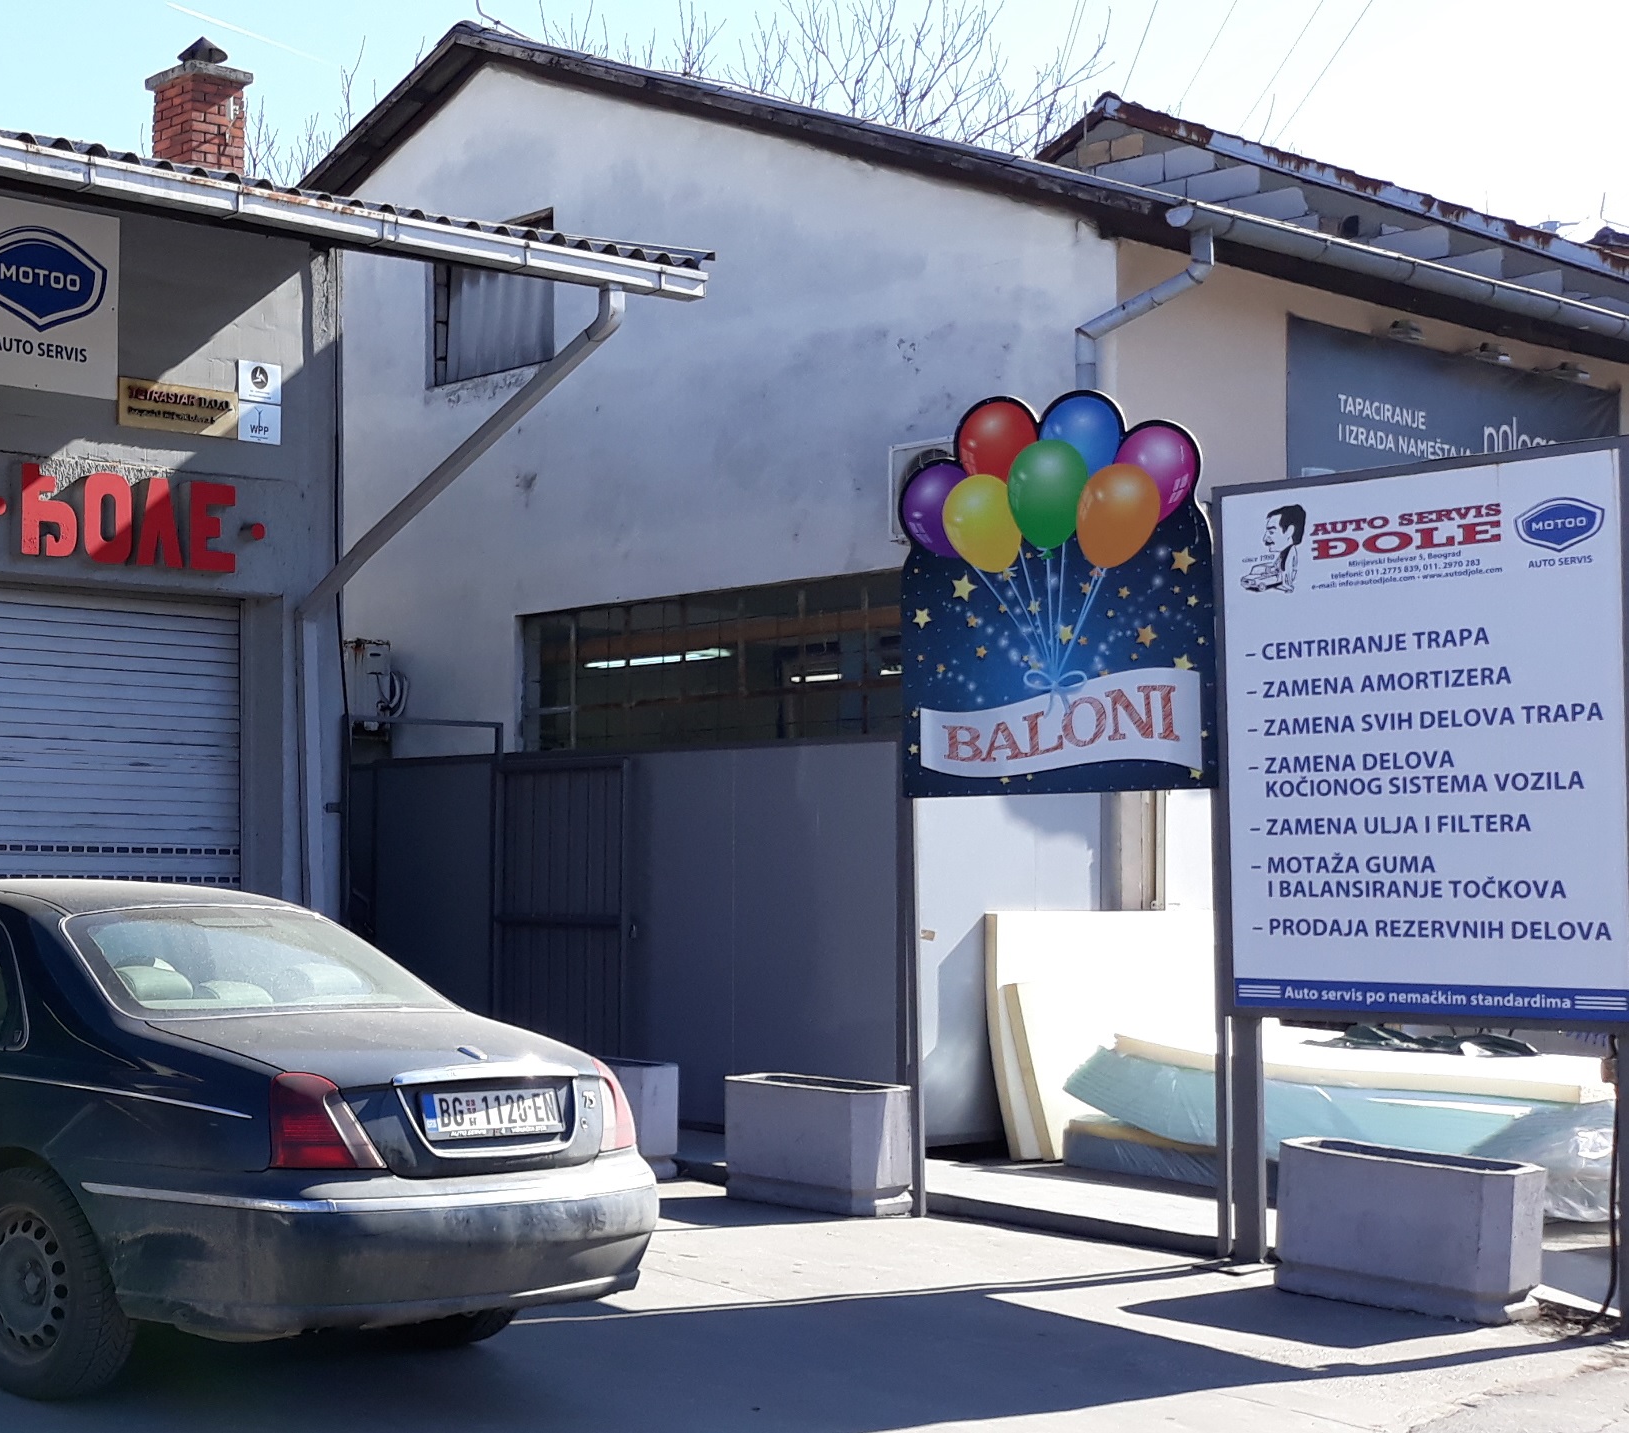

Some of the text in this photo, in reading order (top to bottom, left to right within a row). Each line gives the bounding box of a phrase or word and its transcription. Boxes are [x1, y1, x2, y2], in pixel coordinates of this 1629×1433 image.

[0, 262, 80, 292] MOTOO
[37, 343, 87, 363] SERVIS
[1337, 393, 1426, 430] TAPACIRANJE
[250, 424, 269, 435] WPP
[1345, 425, 1395, 452] IZRADA
[1310, 502, 1502, 536] AUTO SERVIS
[1531, 515, 1587, 533] MOTOO
[1311, 520, 1502, 561] ĐOLE
[1348, 557, 1385, 568] Mirijevski
[1387, 555, 1417, 565] bulevar
[1427, 550, 1462, 562] Beograd
[1443, 560, 1464, 569] 2970
[1528, 554, 1593, 569] AUTO SERVIS
[1422, 566, 1503, 580] www.autodjole.com
[1261, 627, 1490, 661] CENTRIRANJE TRAPA
[1262, 666, 1512, 699] ZAMENA AMORTIZERA
[941, 684, 1181, 763] BALONI
[1263, 702, 1604, 737] ZAMENA SVIH DELOVA TRAPA
[1264, 750, 1455, 774] ZAMENA DELOVA
[1265, 771, 1585, 798] KOČIONOG SISTEMA VOZILA
[1266, 813, 1531, 836] ZAMENA ULJA I FILTERA
[1267, 852, 1436, 874] MOTAŽA GUMA
[1268, 875, 1566, 899] I BALANSIRANJE TOČKOVA
[1268, 918, 1612, 942] PRODAJA REZERVNIH DELOVA
[1284, 986, 1571, 1009] Auto servis po nemačkim standardima
[582, 1091, 595, 1109] 75
[439, 1097, 464, 1128] BG
